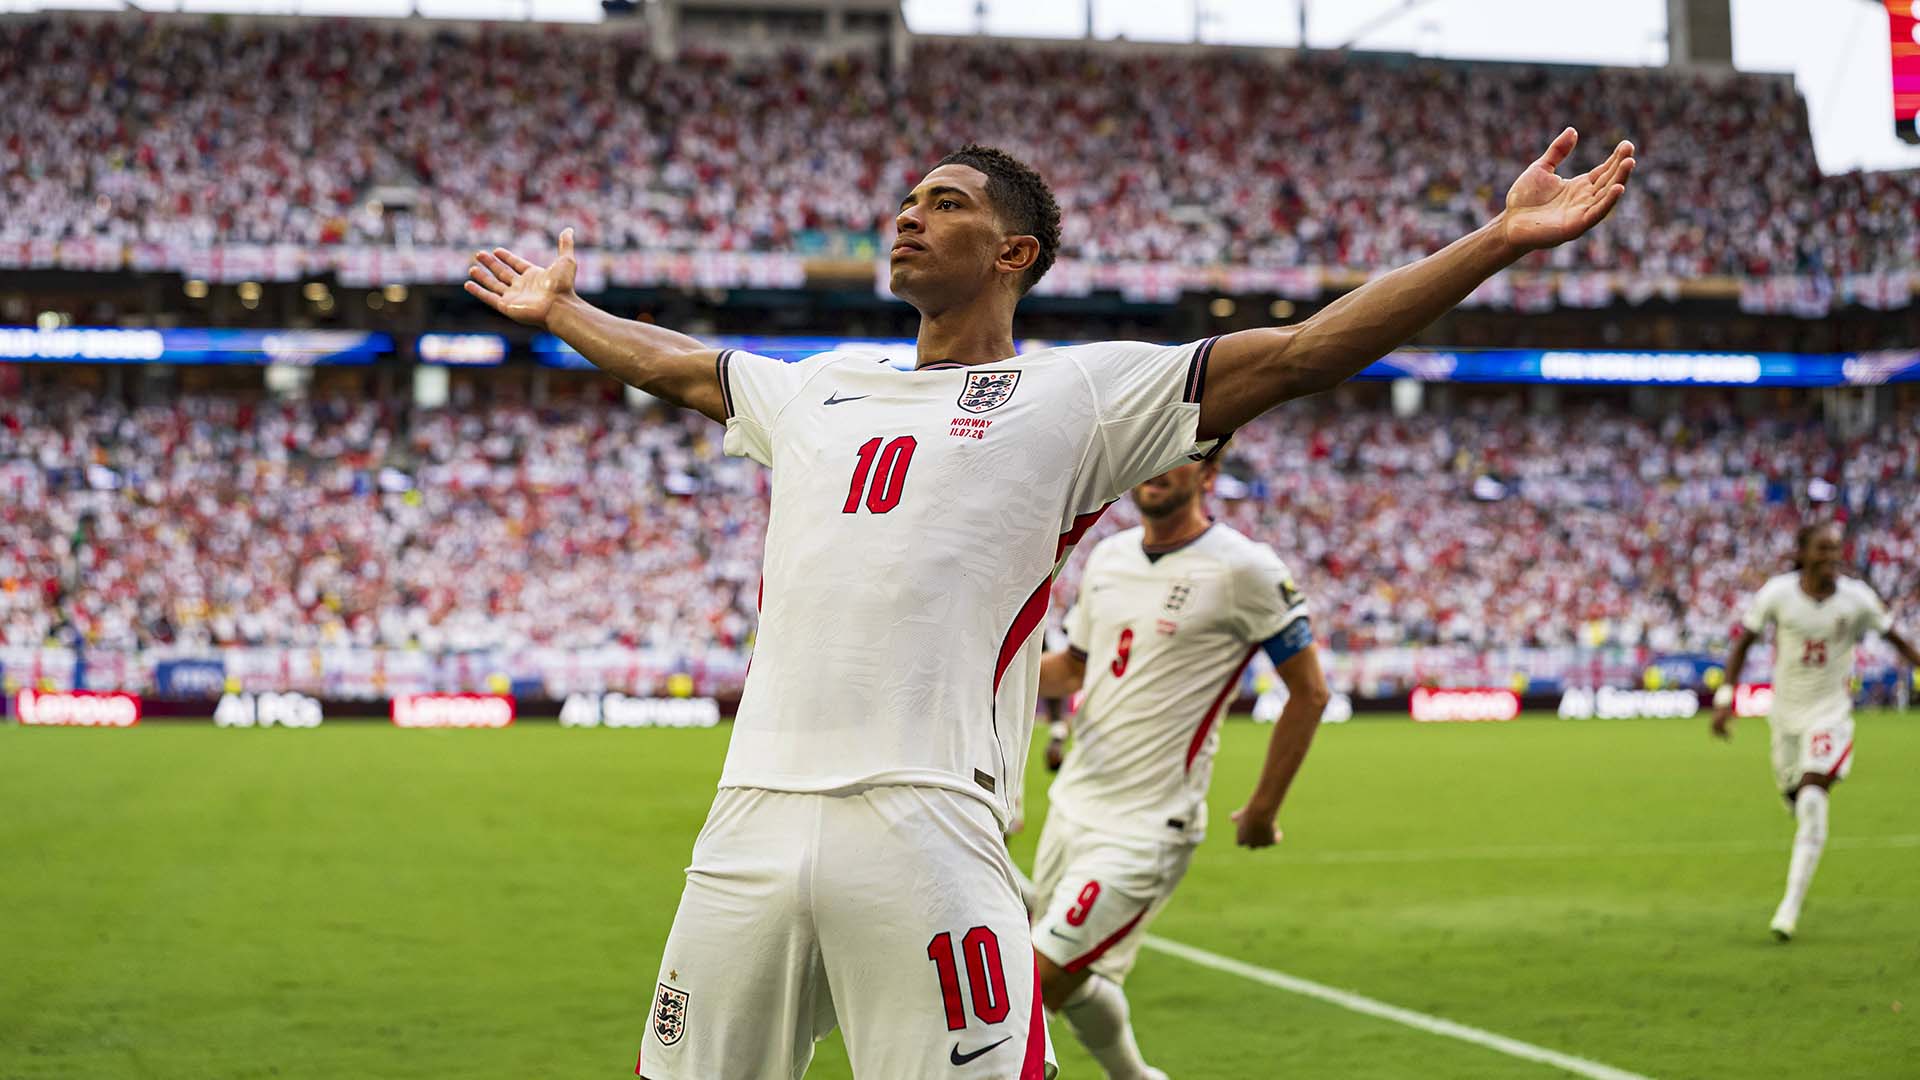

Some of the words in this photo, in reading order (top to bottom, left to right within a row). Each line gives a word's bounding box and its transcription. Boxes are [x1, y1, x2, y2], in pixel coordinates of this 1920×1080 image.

[949, 427, 985, 440] 11.07.26
[950, 417, 993, 429] NORWAY
[842, 435, 917, 514] 10
[1110, 627, 1134, 678] 9
[18, 688, 138, 726] Lenovo
[213, 692, 256, 727] AI
[257, 691, 323, 727] PCs
[392, 692, 514, 727] Lenovo
[559, 692, 601, 727] AI
[602, 692, 721, 728] Servers
[1411, 686, 1520, 721] Lenovo
[1066, 880, 1101, 927] 9
[926, 925, 1012, 1032] 10
